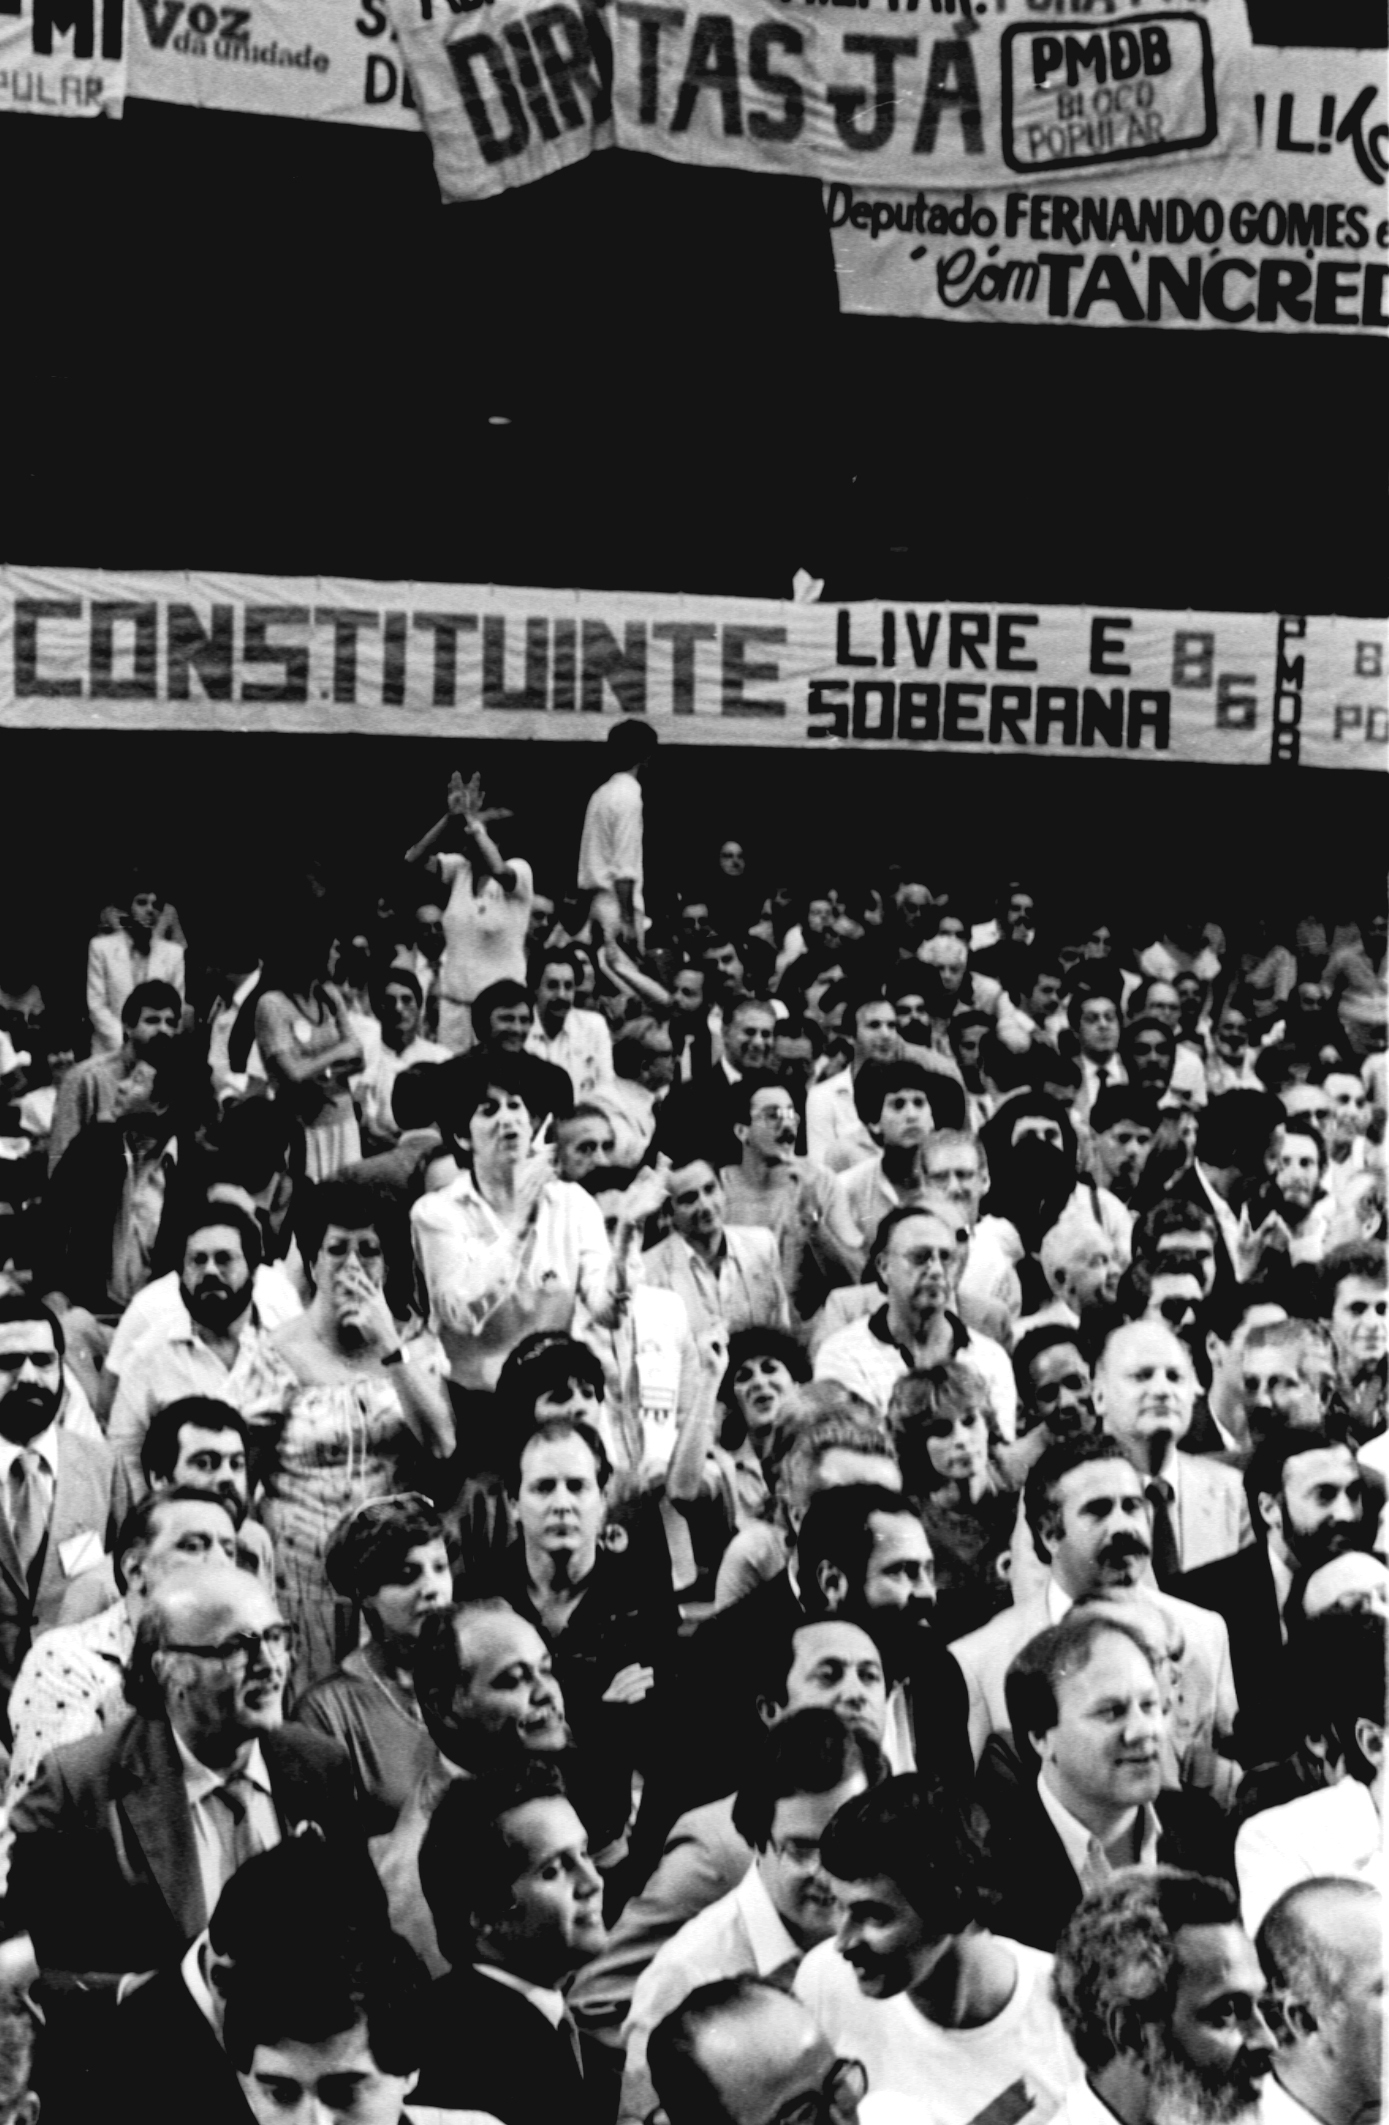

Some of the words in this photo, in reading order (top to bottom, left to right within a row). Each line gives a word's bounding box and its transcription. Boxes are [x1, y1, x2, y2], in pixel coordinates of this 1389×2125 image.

[173, 29, 208, 57] da
[213, 34, 331, 74] unidade
[1031, 25, 1172, 88] PMDB
[1057, 79, 1155, 121] BLOCO
[1027, 110, 1166, 159] POPULAR
[827, 182, 998, 239] Deputado
[1004, 191, 1225, 245] FERNANDO
[1229, 200, 1370, 249] GOMES
[13, 599, 788, 718] CONSTITUINTE
[836, 607, 1040, 671] LIVRE
[1089, 616, 1133, 677] E
[806, 679, 1172, 750] SOBERANA
